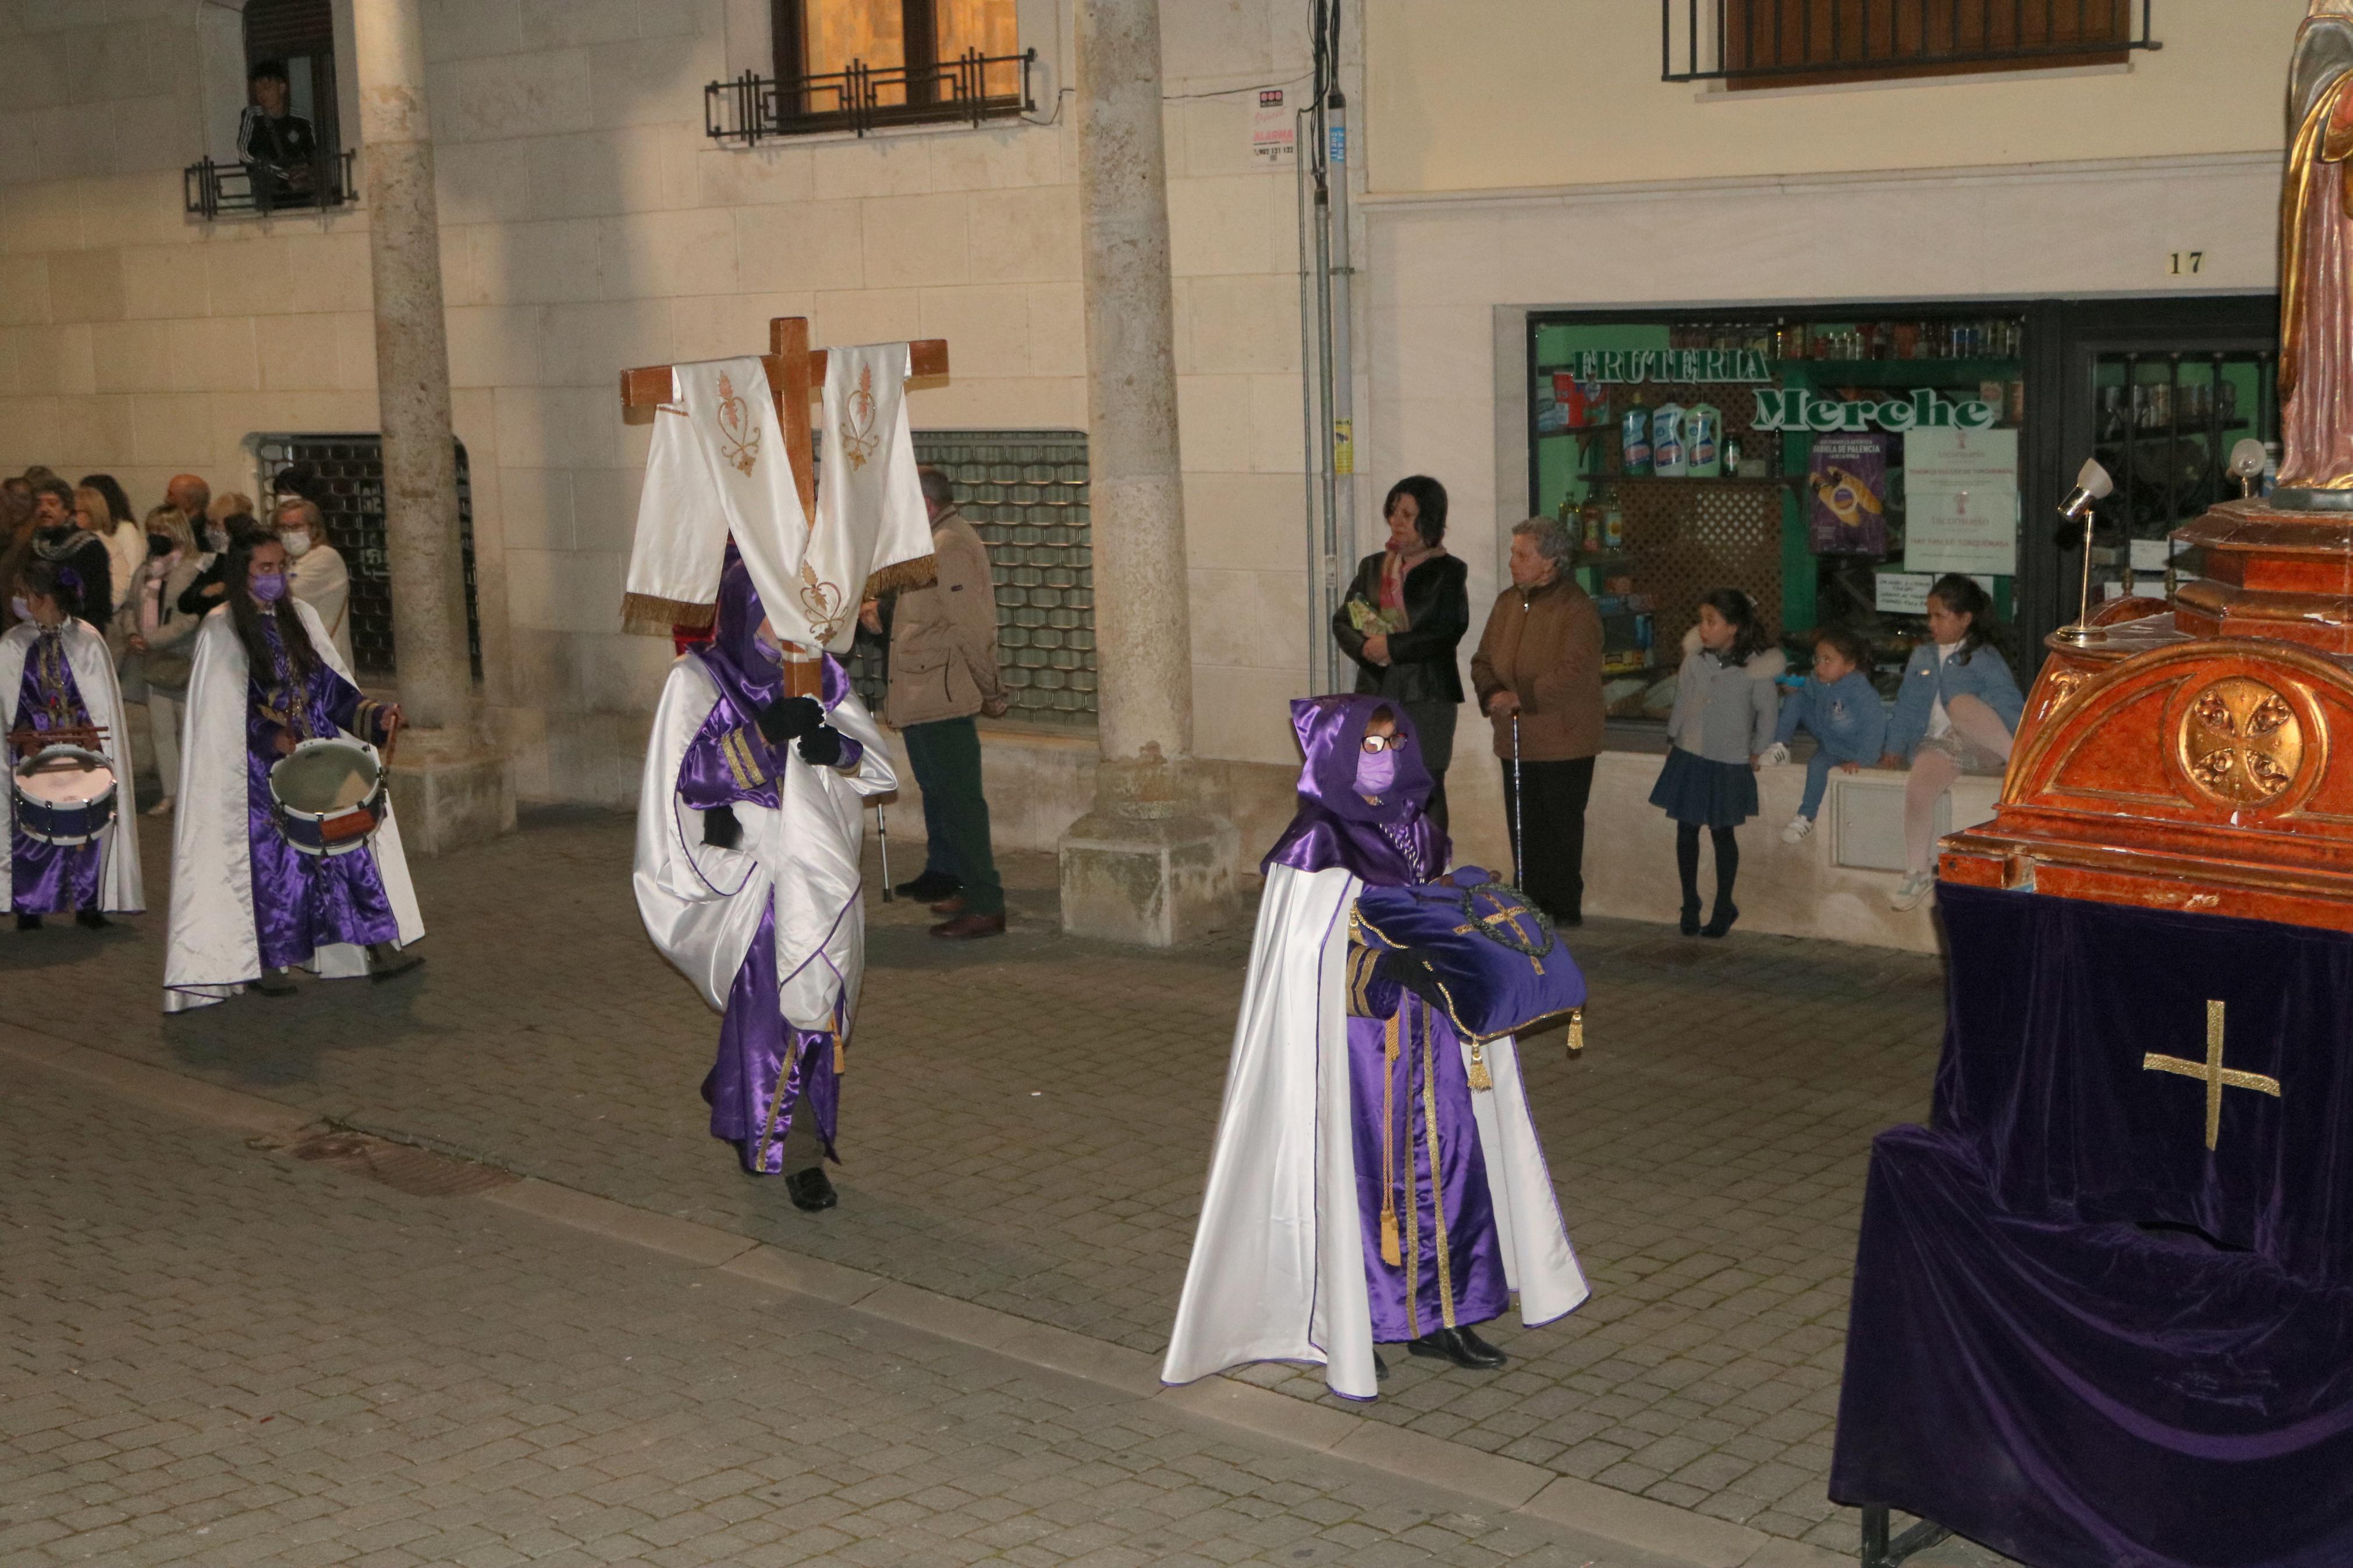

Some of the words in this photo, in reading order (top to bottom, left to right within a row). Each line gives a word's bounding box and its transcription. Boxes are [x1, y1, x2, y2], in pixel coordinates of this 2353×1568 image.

[2171, 251, 2202, 273] 17
[1573, 349, 1772, 384] FRUTERIA
[1751, 388, 1994, 432] Merche
[1847, 445, 1880, 453] PALENCIA
